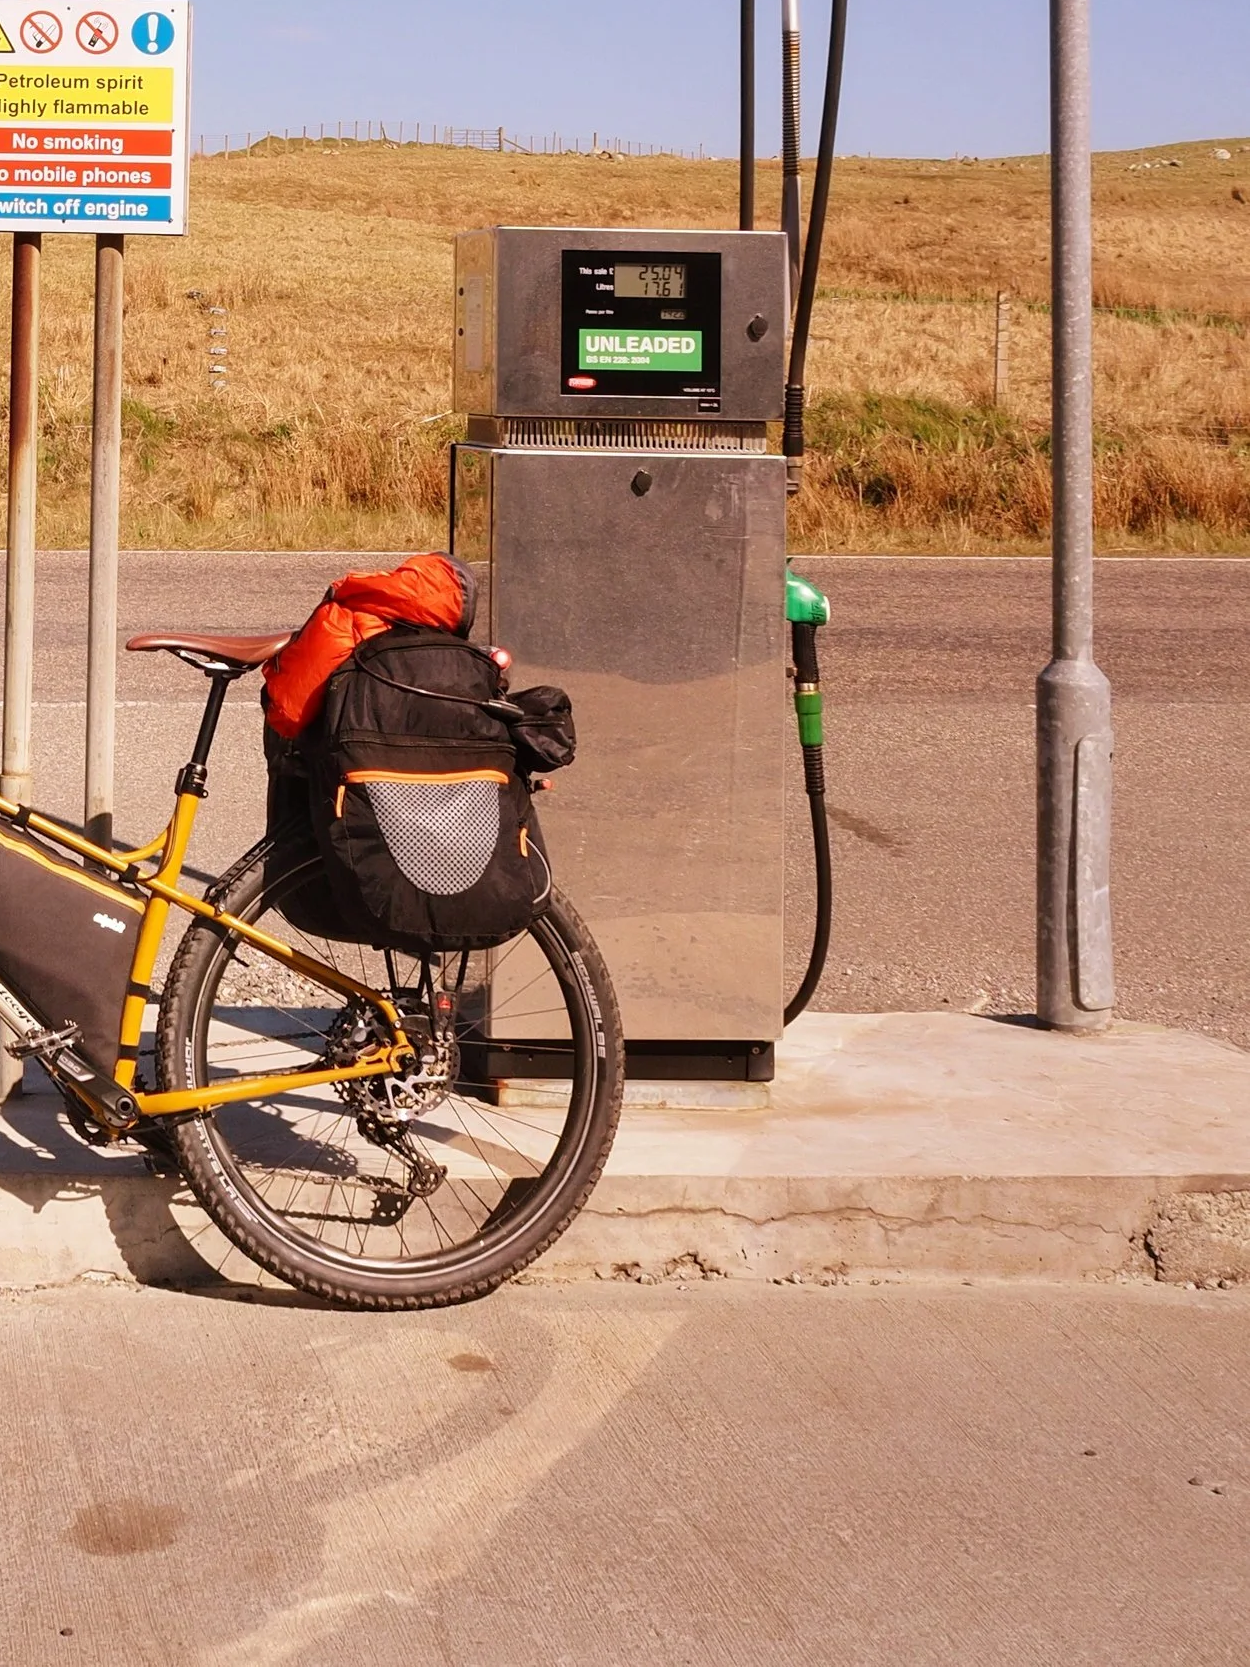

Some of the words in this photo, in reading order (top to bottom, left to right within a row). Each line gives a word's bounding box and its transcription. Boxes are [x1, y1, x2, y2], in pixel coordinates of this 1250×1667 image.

[96, 75, 144, 93] spirit
[53, 99, 149, 116] flammable
[12, 133, 38, 150] No
[43, 134, 124, 155] smoking
[14, 166, 77, 183] mobile
[82, 168, 152, 187] phones
[53, 199, 81, 216] off
[84, 200, 148, 219] engine
[579, 267, 592, 275] This
[639, 265, 683, 281] 25.04
[595, 283, 614, 291] Litres
[644, 281, 683, 297] 17.61
[586, 336, 696, 354] UNLEADED
[586, 355, 598, 364] BS
[599, 356, 611, 364] EN
[571, 951, 607, 1058] SCHWALBE
[195, 1120, 220, 1174] ATTS
